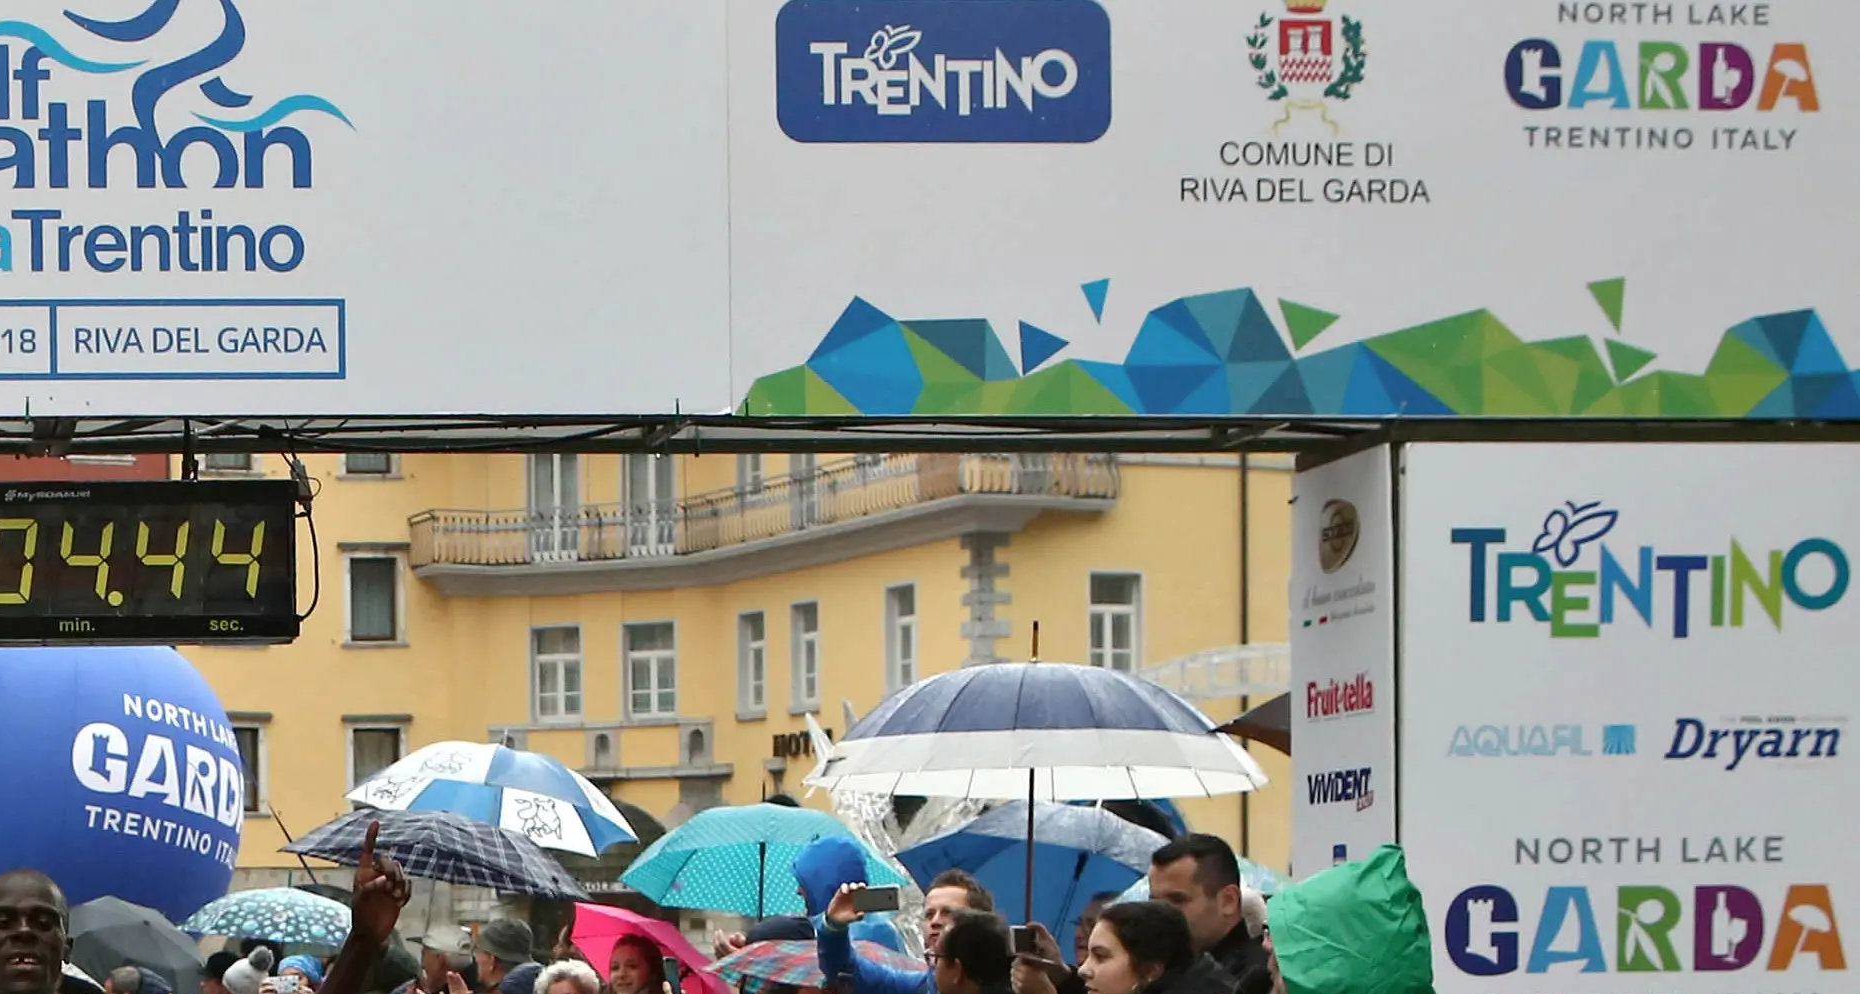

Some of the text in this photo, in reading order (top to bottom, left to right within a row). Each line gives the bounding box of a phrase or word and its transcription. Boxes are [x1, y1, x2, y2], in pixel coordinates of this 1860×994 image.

[1558, 2, 1769, 26] NORTH LAKE
[810, 42, 1078, 115] TRENTINO
[1504, 38, 1821, 111] GARDA
[1220, 142, 1392, 167] COMUNE DI
[1524, 127, 1797, 150] TRENTINO ITALY
[1179, 178, 1430, 203] RIVA DEL GARDA
[74, 327, 141, 353] RIVA
[153, 327, 209, 353] DEL
[218, 327, 326, 353] GARDA
[1451, 528, 1850, 637] TRENTINO
[59, 618, 96, 632] min.
[209, 619, 244, 632] sec.
[1307, 674, 1373, 718] Fruit-tella
[123, 693, 207, 737] NORTH
[1449, 725, 1591, 756] AQUAFIL
[1664, 717, 1840, 770] Dryarn
[84, 804, 211, 855] TRENTINO
[1515, 836, 1785, 865] NORTH LAKE
[1445, 884, 1847, 976] GARDA
